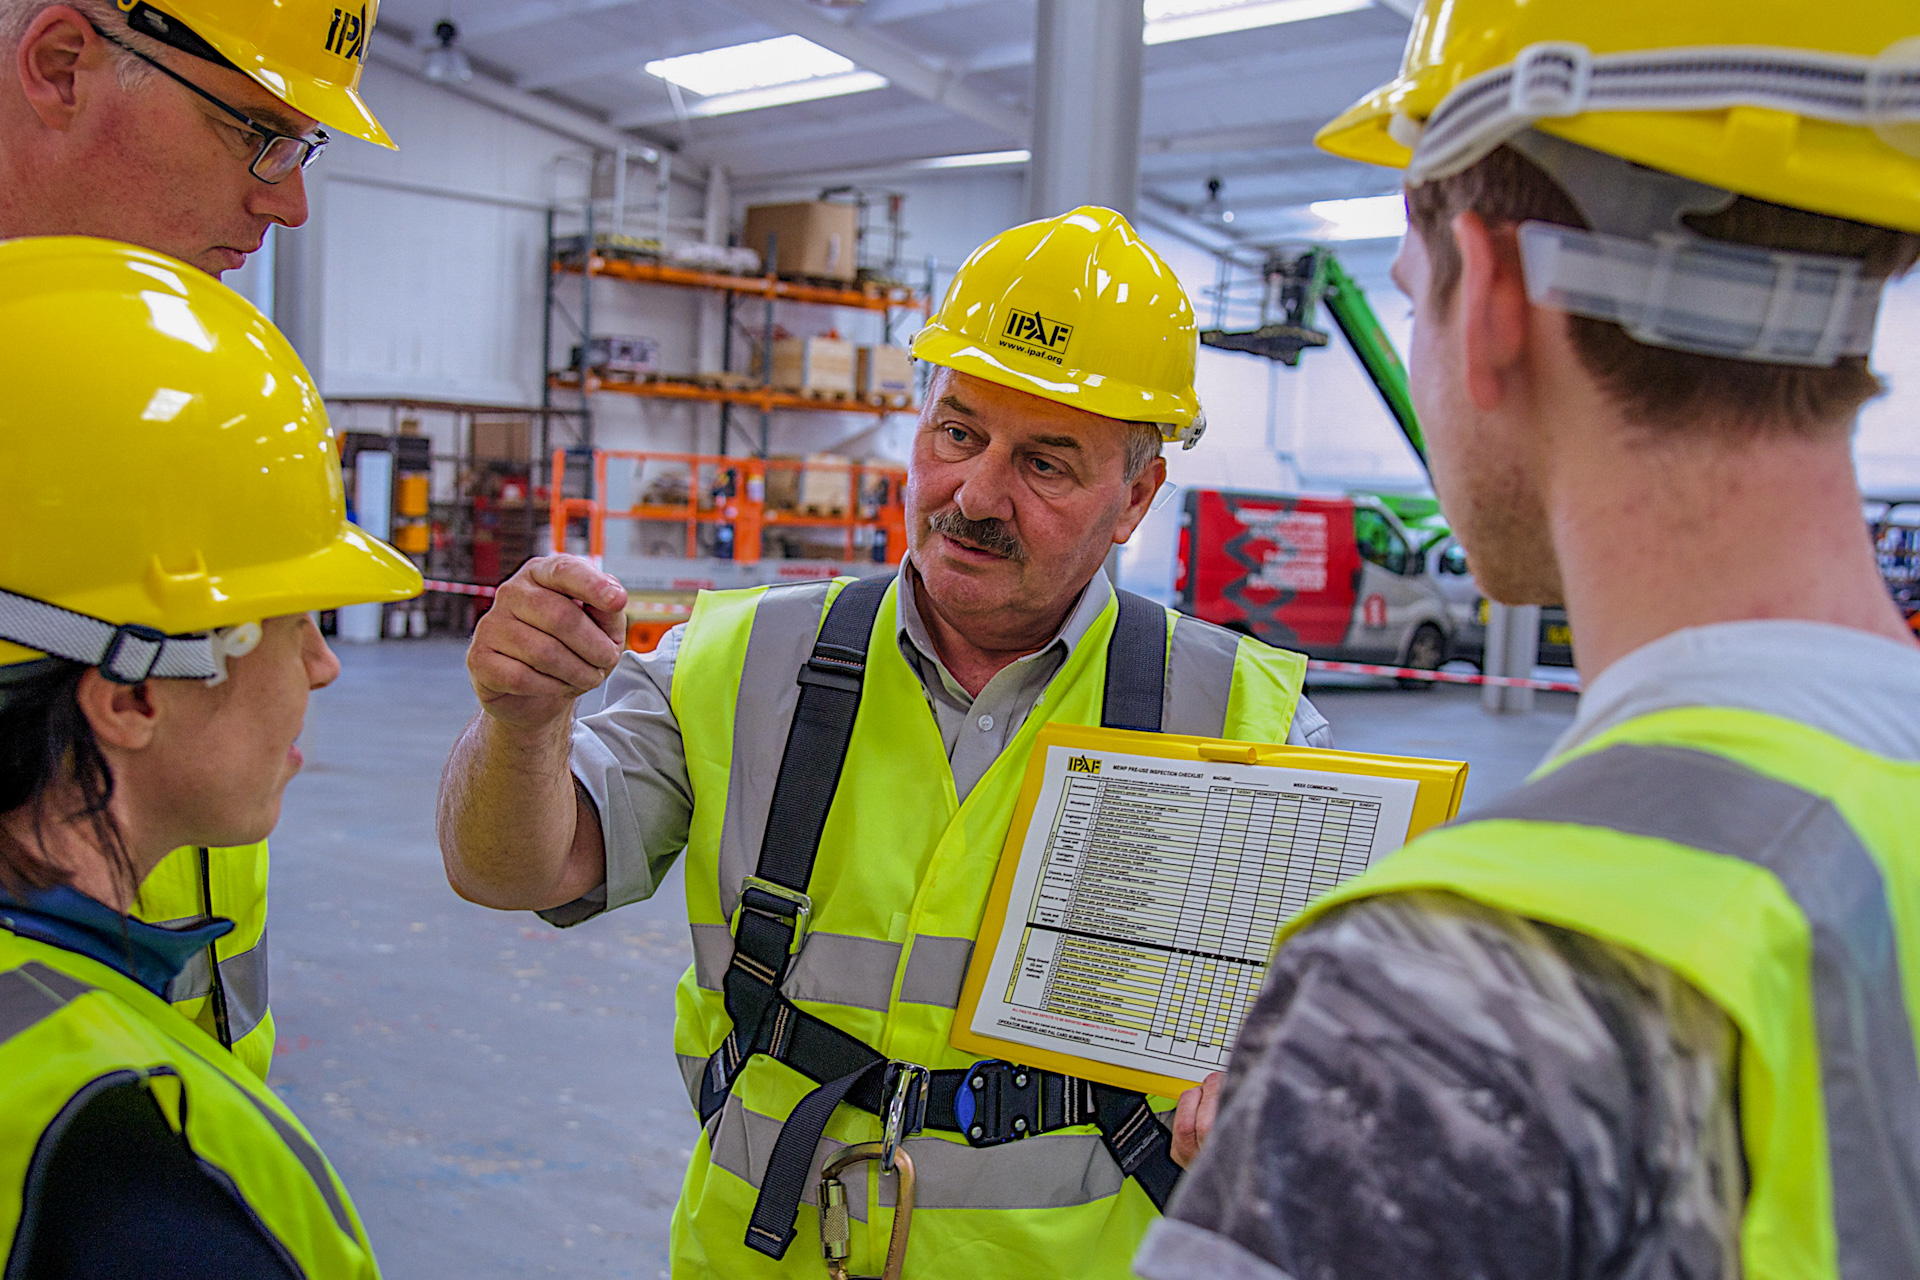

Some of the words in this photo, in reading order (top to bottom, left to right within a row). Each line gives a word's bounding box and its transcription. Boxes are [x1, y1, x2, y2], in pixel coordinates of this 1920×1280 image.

[325, 3, 366, 62] IPA
[1006, 311, 1069, 347] IPAF
[999, 339, 1063, 365] www.ipaf.org
[1069, 754, 1101, 774] IPAF
[998, 1019, 1020, 1027] OPERATOR
[1069, 1034, 1091, 1043] NUMBER(S)
